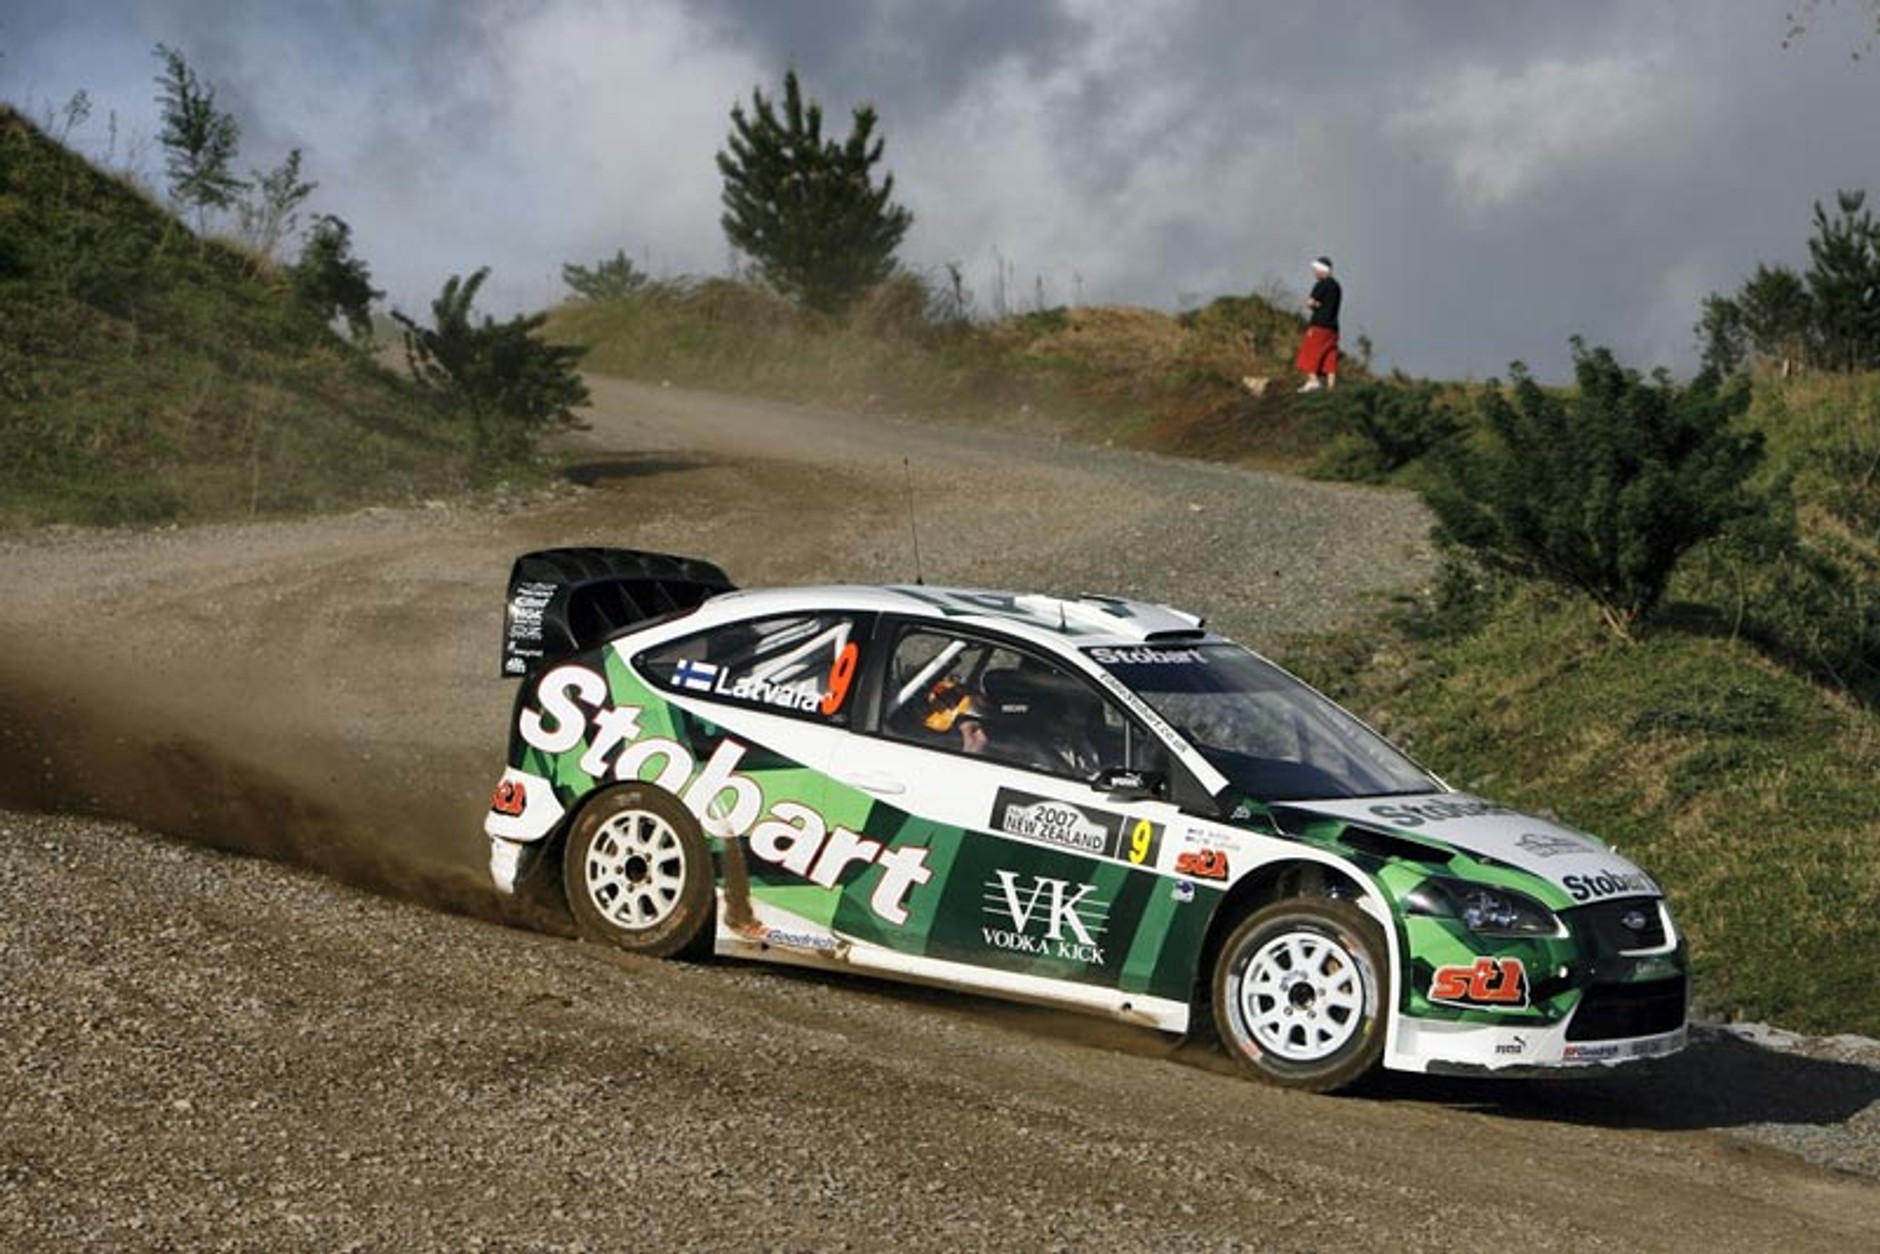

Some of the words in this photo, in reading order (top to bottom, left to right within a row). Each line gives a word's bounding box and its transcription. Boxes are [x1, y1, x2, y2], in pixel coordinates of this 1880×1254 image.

[822, 641, 860, 716] 9
[1090, 648, 1209, 664] Stobart
[713, 665, 820, 713] Latvala
[518, 663, 932, 926] Stobart
[1035, 806, 1079, 829] 2007
[1006, 814, 1038, 834] NEW
[1039, 823, 1104, 849] ZEALAND
[1128, 818, 1153, 866] 9
[994, 869, 1098, 946] VK
[981, 926, 1050, 955] VODKA
[1057, 941, 1105, 965] KICK
[1430, 956, 1527, 1007] st1
